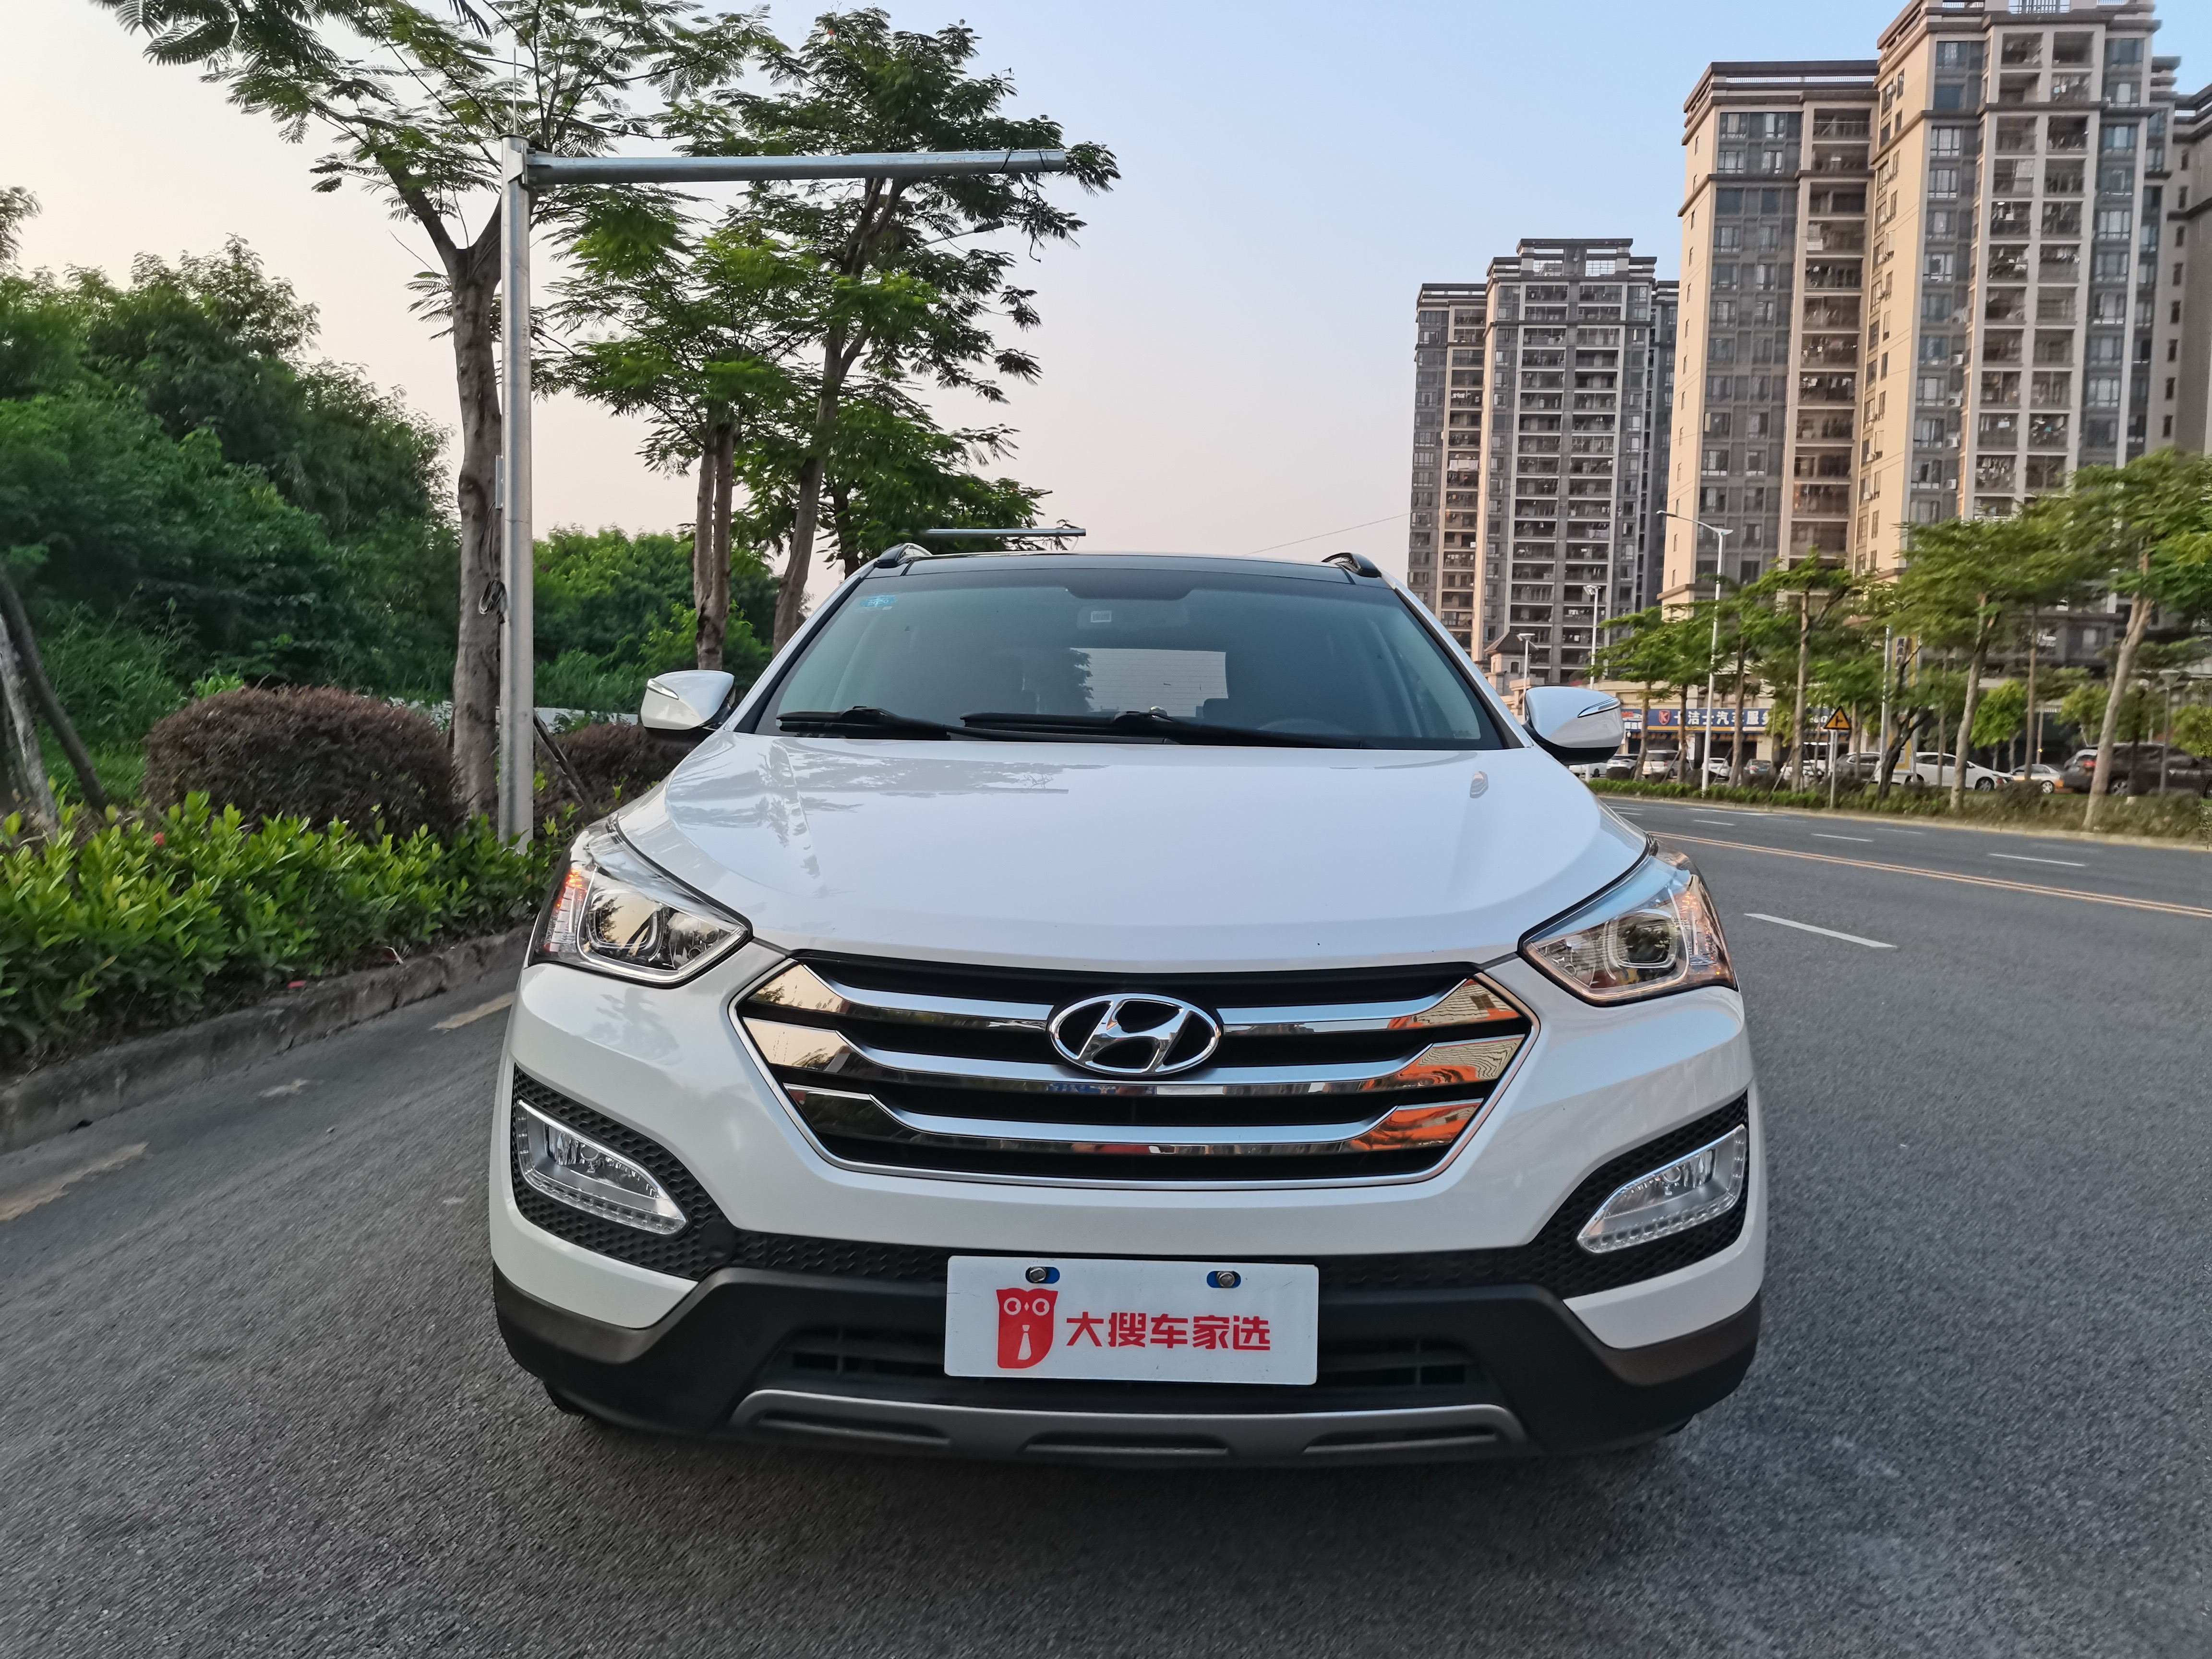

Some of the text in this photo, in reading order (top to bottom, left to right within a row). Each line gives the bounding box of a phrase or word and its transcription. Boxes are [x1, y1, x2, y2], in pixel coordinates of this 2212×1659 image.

[1066, 1311, 1271, 1351] 大搜车家选
